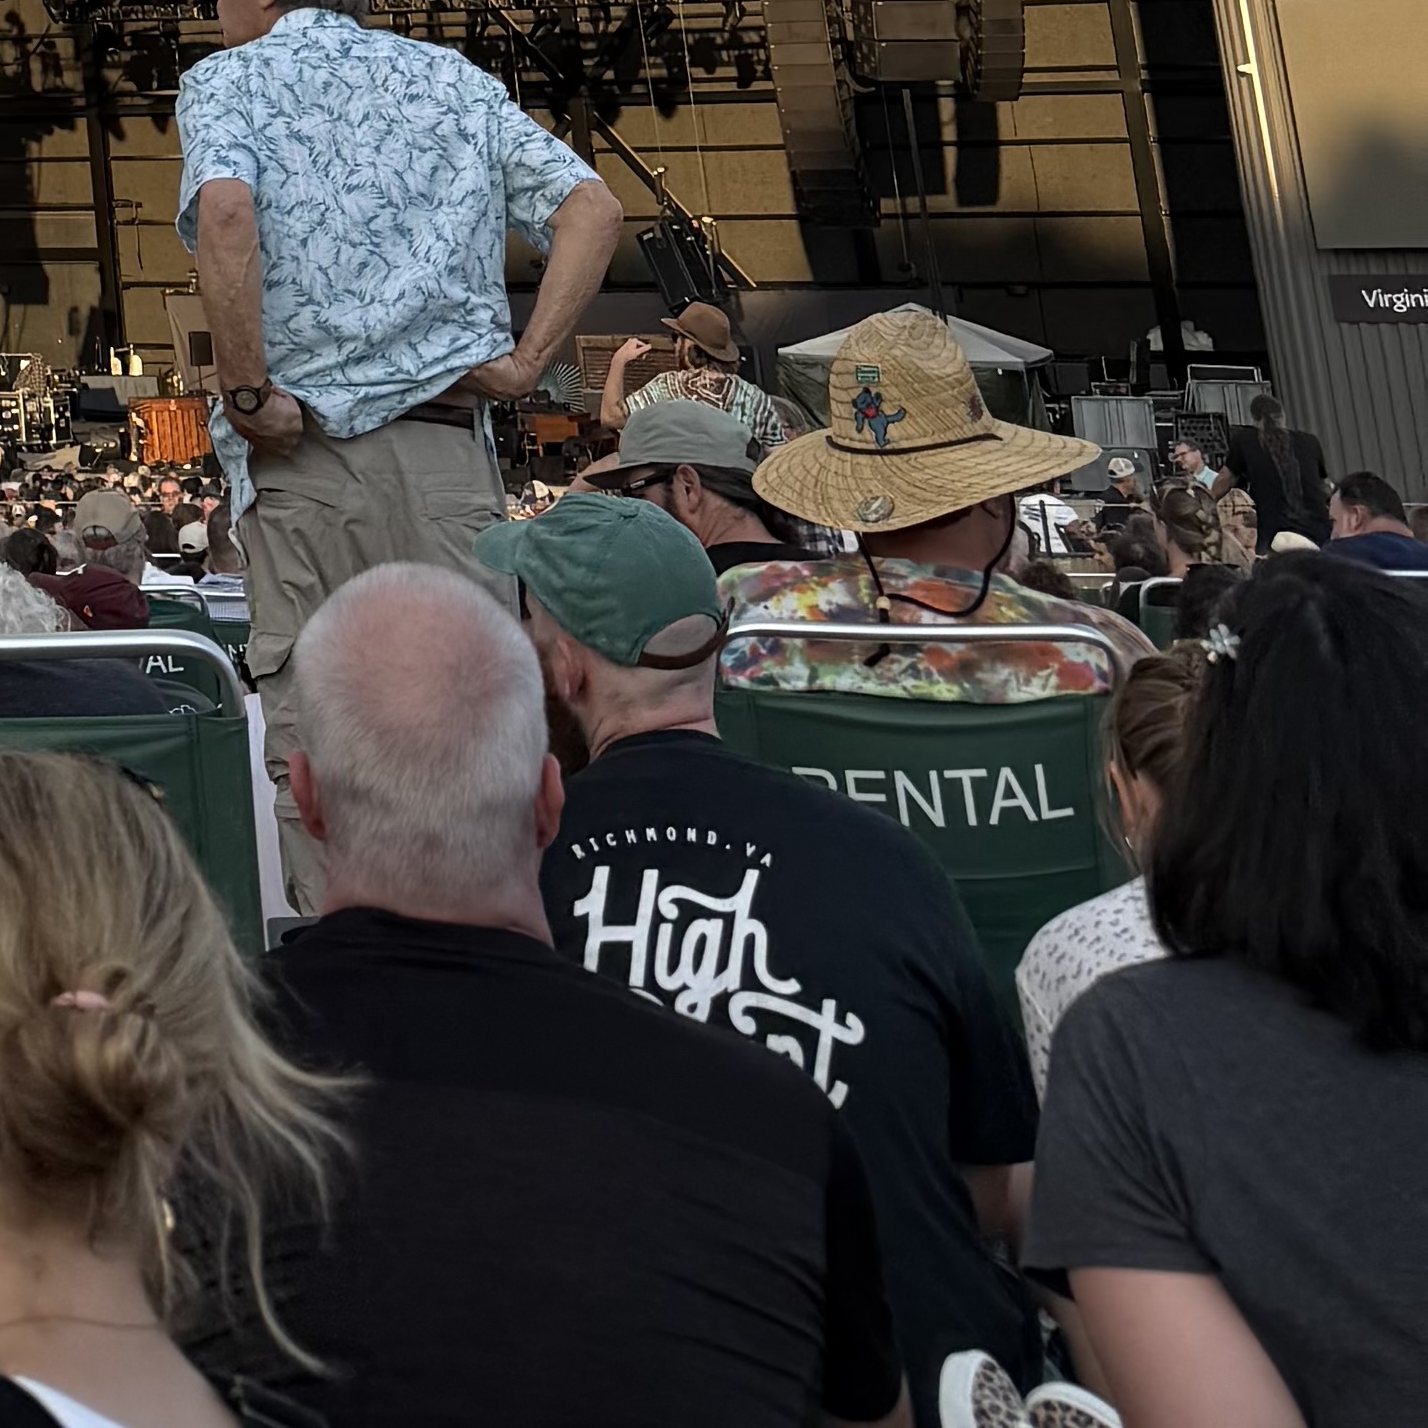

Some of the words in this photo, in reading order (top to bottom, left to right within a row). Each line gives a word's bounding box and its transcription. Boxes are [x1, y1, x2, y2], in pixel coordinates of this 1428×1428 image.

[1361, 288, 1428, 313] Virgini
[744, 842, 773, 868] VA
[573, 865, 802, 1024] High
